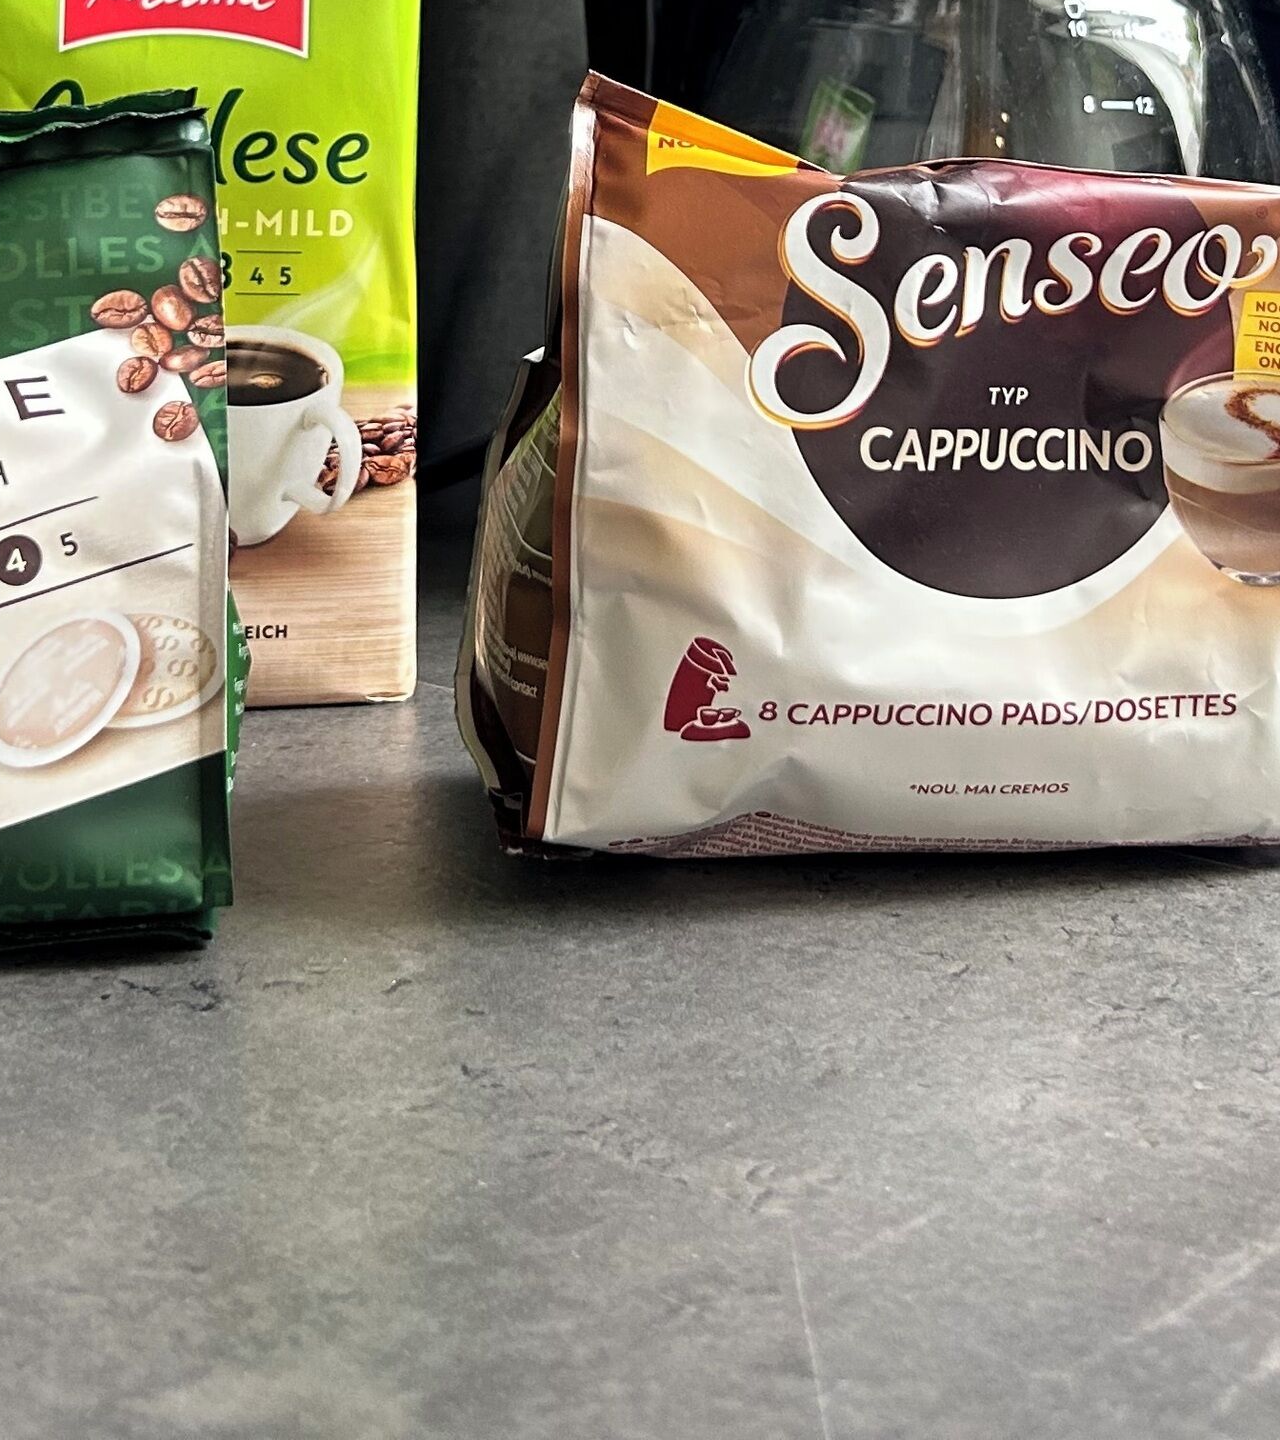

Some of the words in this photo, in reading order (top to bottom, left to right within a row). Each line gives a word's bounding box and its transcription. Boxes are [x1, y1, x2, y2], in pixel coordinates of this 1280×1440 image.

[1067, 20, 1088, 37] 10
[1135, 95, 1156, 116] 12
[249, 267, 264, 285] 4
[279, 267, 292, 285] 5
[744, 191, 1279, 431] Senseo
[988, 387, 1029, 407] TYP
[859, 426, 1155, 473] CAPPUCCINO
[5, 548, 28, 573] 4
[60, 532, 80, 556] 5
[758, 701, 778, 721] 8
[787, 702, 993, 726] CAPPUCCINO
[1001, 693, 1238, 726] PADS/DOSETTES
[964, 783, 996, 795] MAI
[999, 782, 1070, 796] CREMOS
